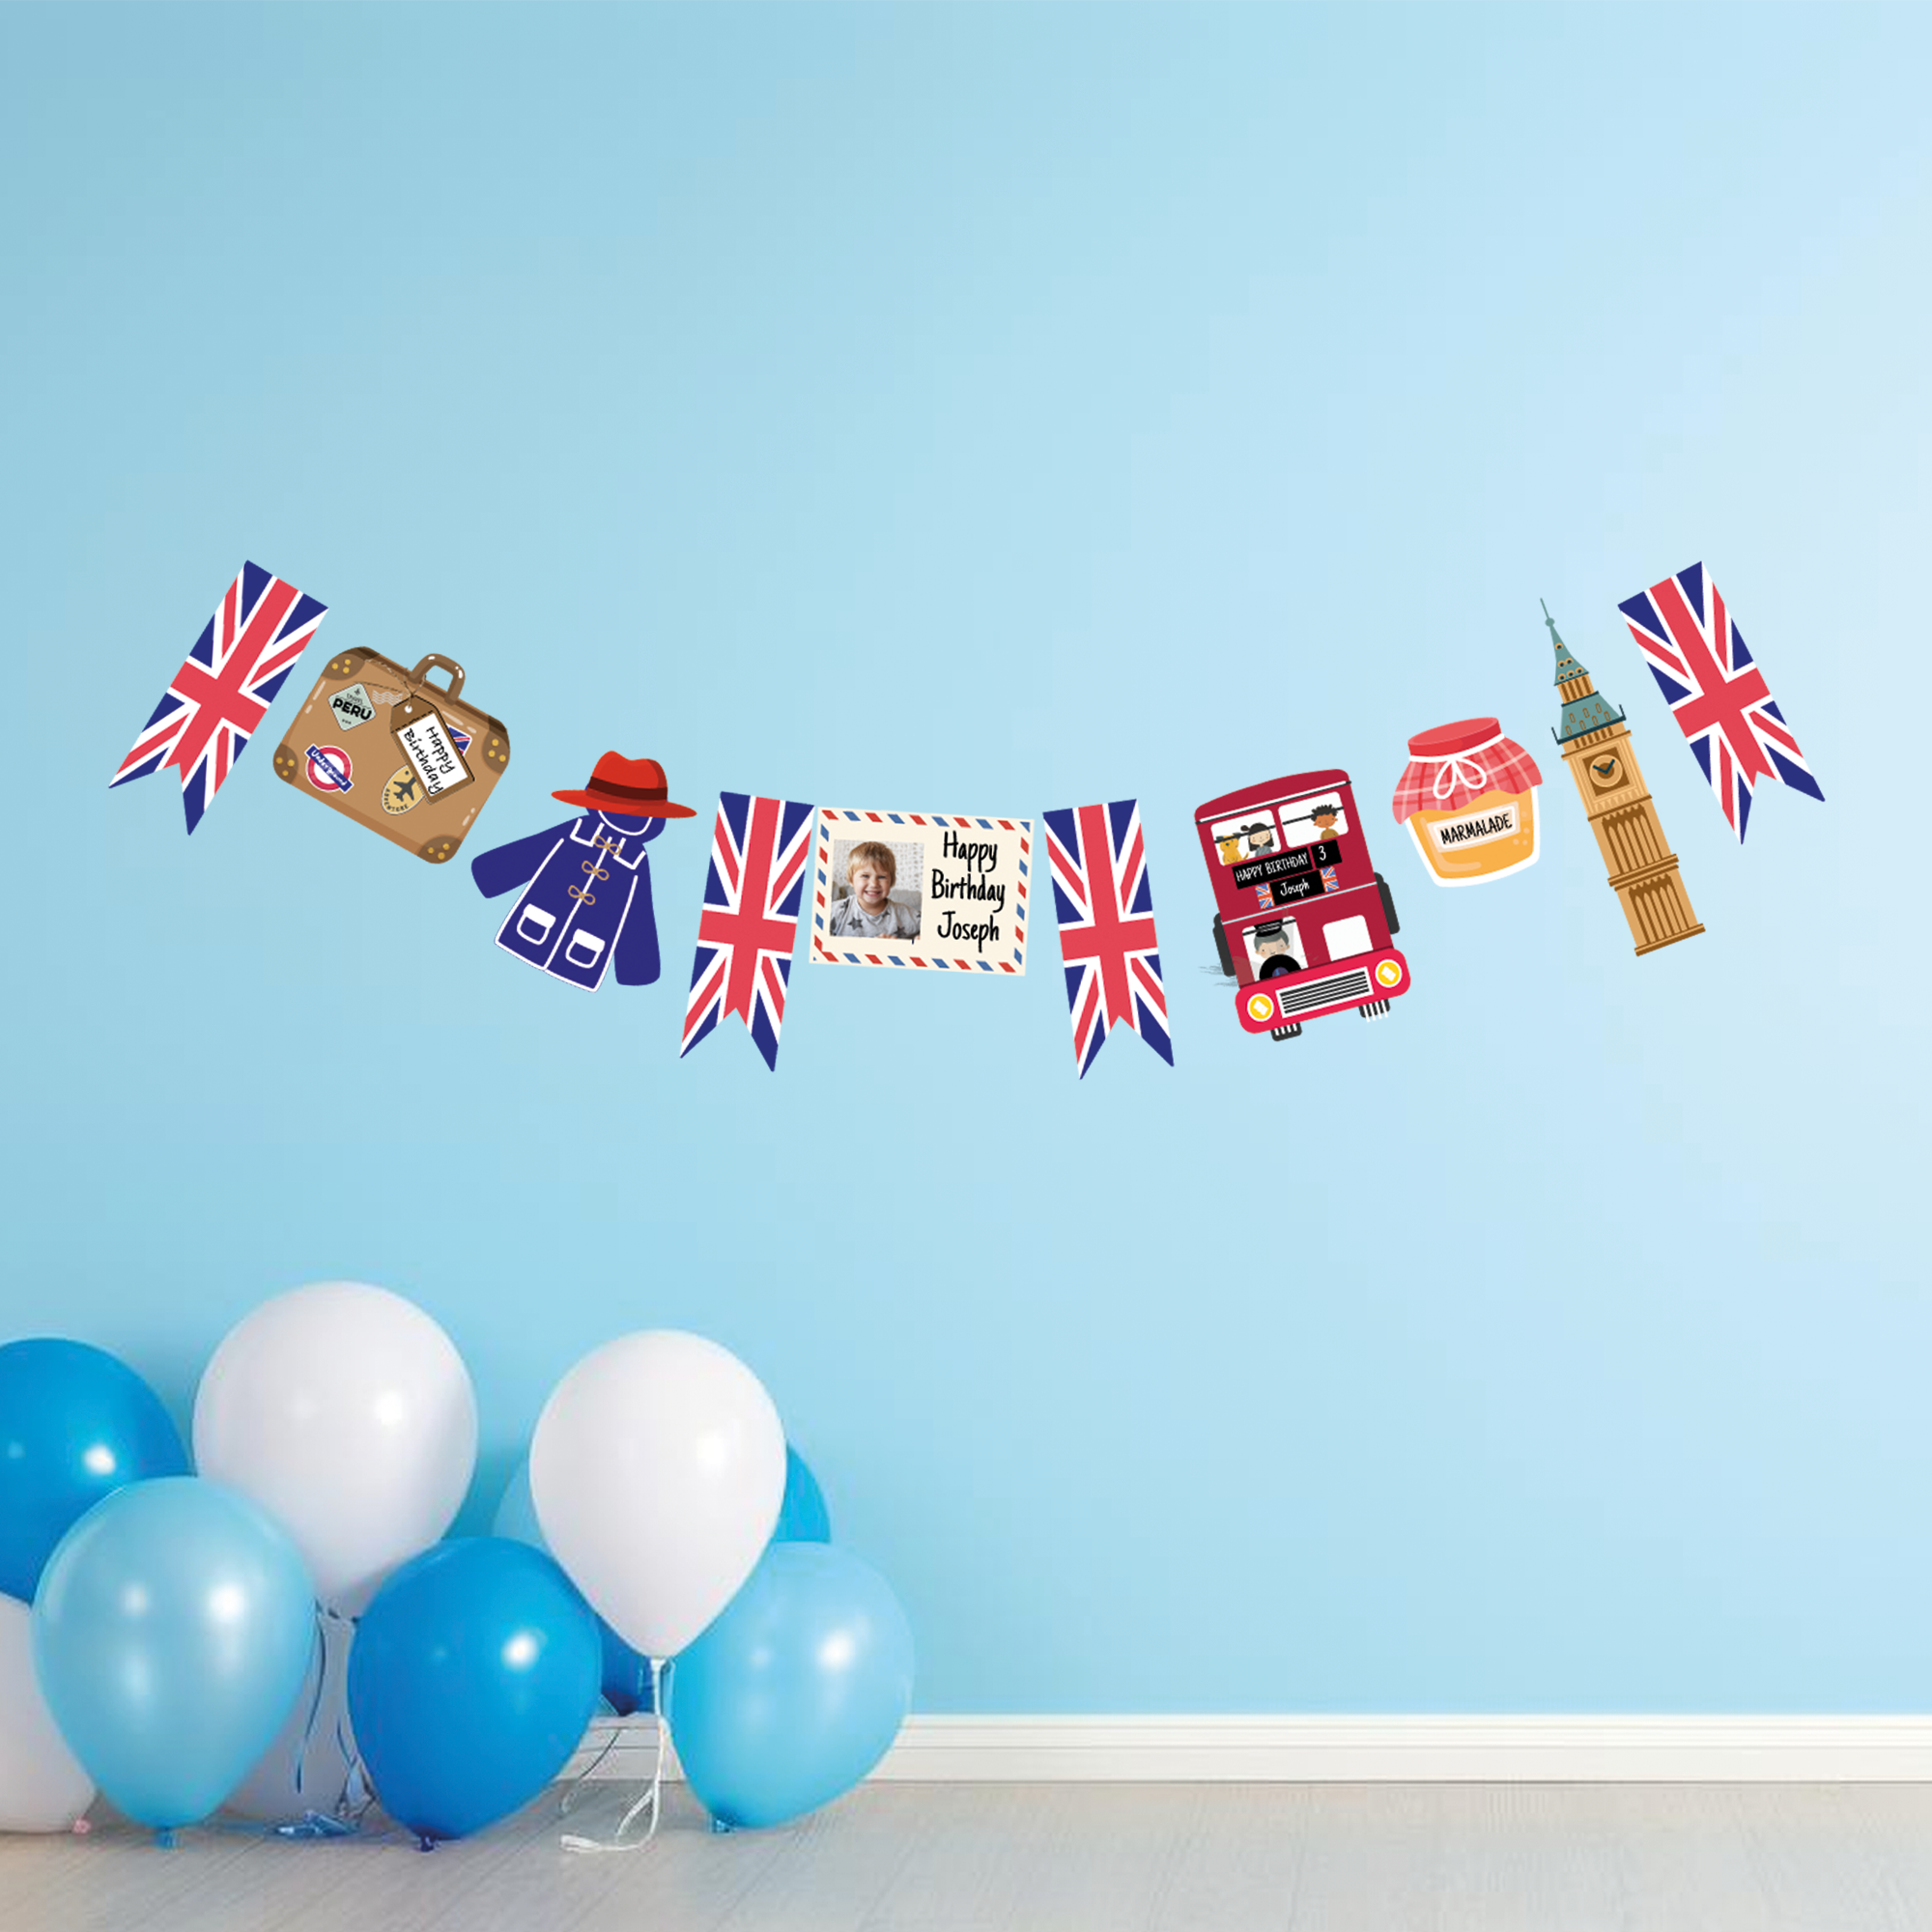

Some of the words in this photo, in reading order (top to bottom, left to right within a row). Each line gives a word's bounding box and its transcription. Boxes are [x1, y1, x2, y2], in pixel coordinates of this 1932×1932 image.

[332, 697, 372, 721] PERU
[404, 727, 444, 795] Birthday
[426, 725, 456, 774] Happy
[1440, 812, 1513, 845] MARMALADE
[943, 830, 998, 873] Happy
[1236, 864, 1264, 882] HAPPY
[1264, 852, 1309, 875] BIRTHDAY
[1318, 845, 1327, 862] 3
[931, 868, 1006, 913] Birthday
[1280, 877, 1311, 897] Joseph
[937, 911, 1000, 953] Joseph
